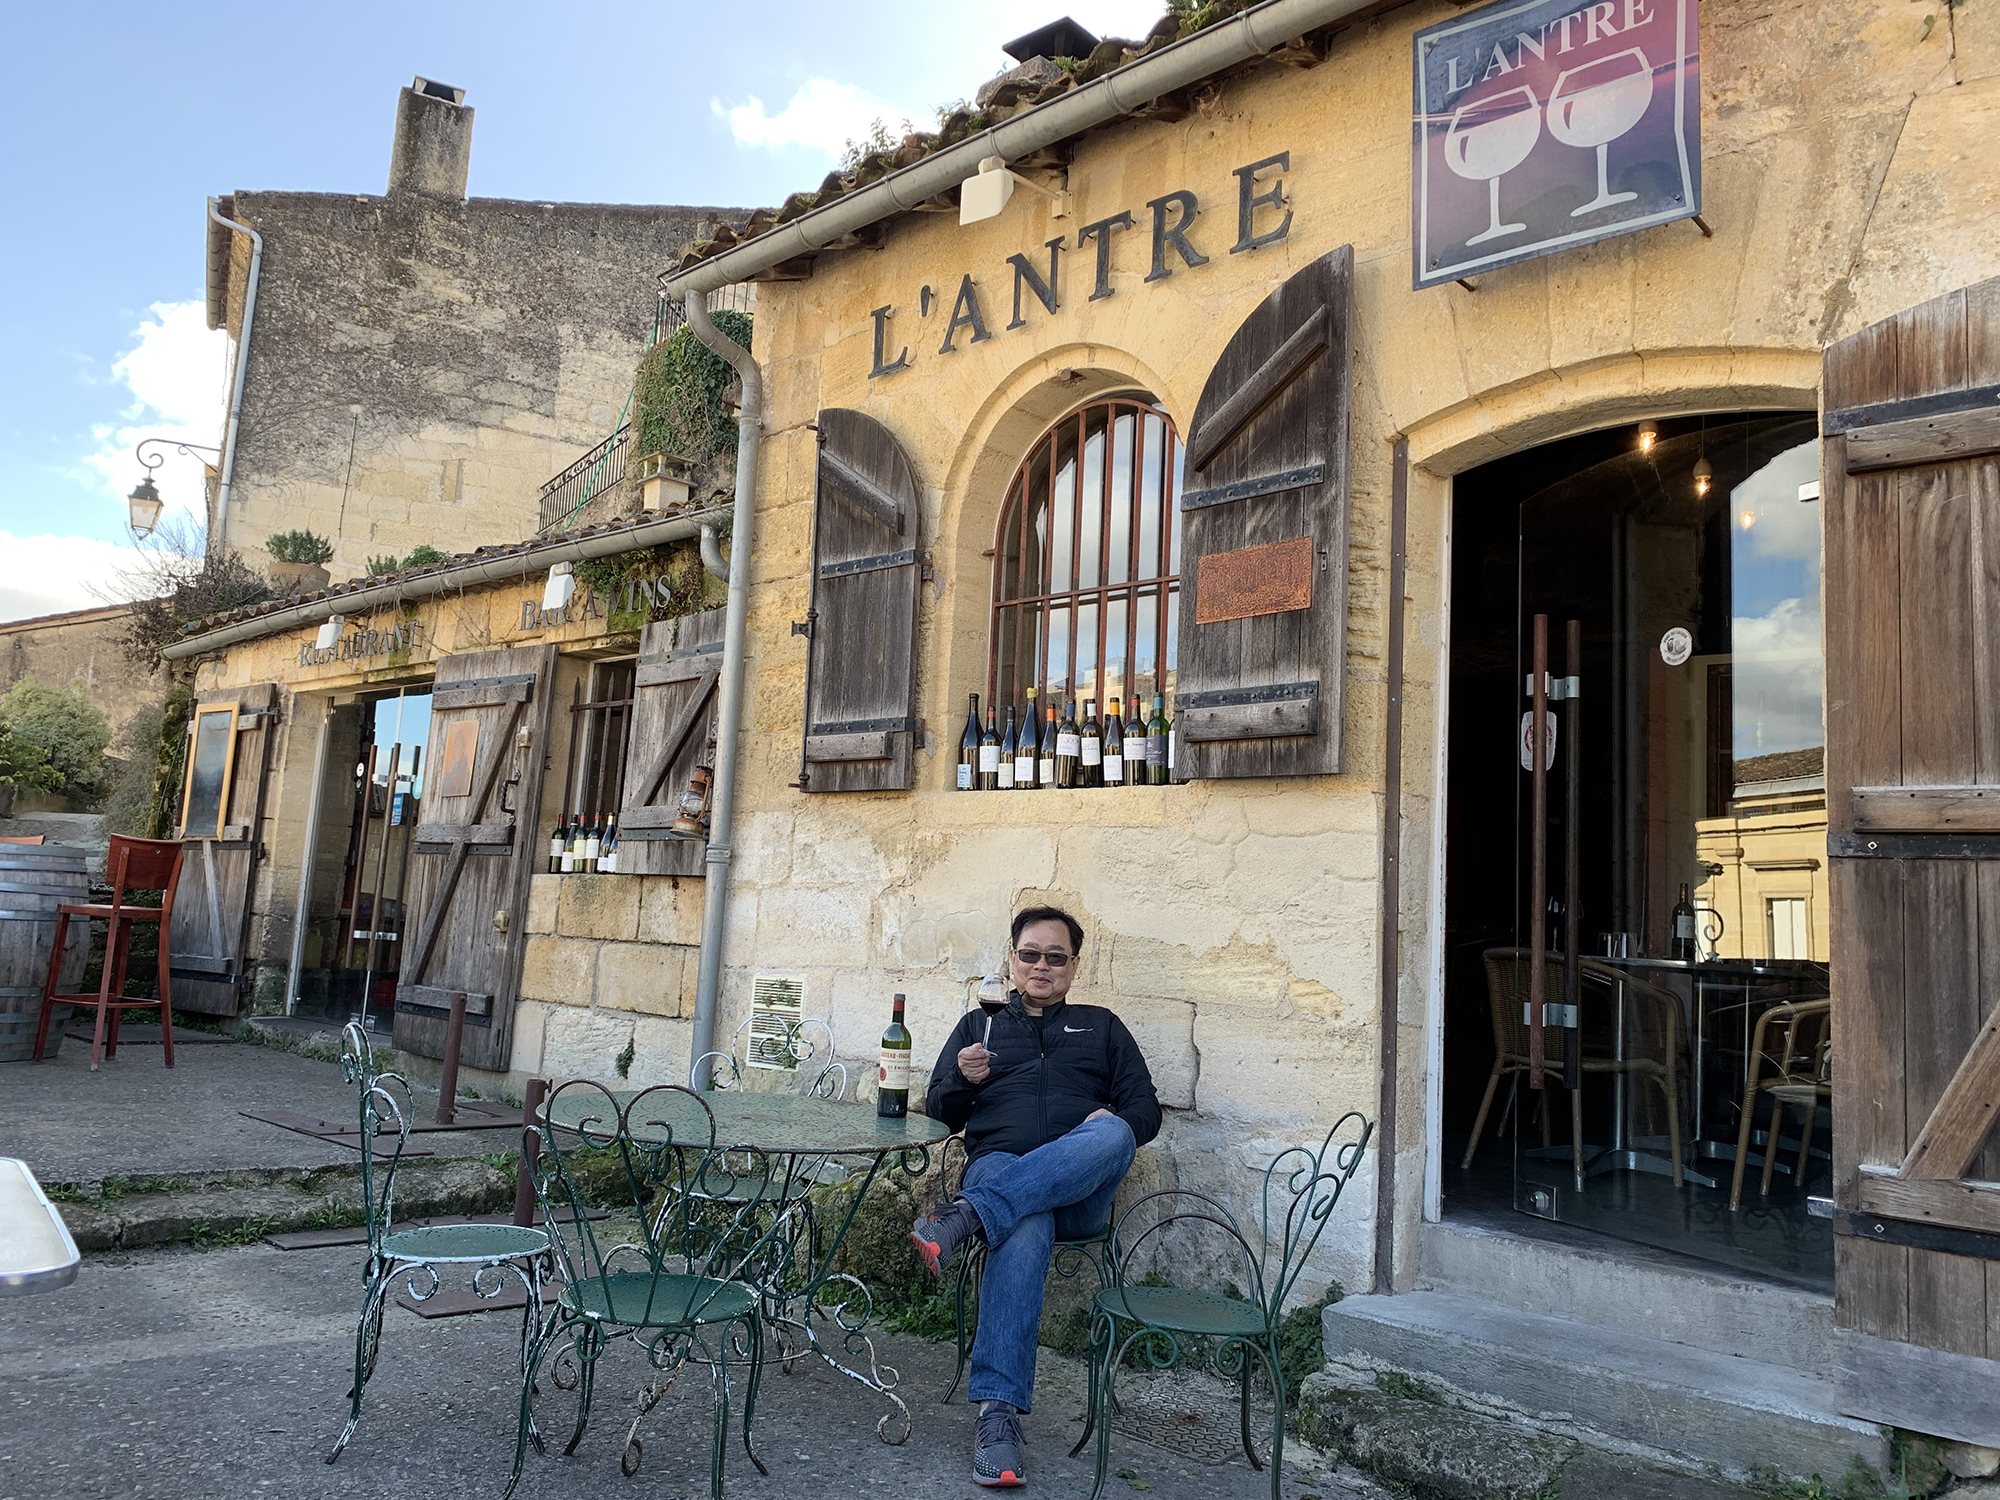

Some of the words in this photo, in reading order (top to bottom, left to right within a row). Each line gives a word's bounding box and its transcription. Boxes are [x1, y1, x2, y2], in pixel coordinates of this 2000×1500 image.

[1445, 0, 1655, 95] L'ANTRE
[868, 150, 1293, 379] L'ANTRE
[609, 574, 671, 615] VINS
[299, 620, 419, 668] RESTAURANT
